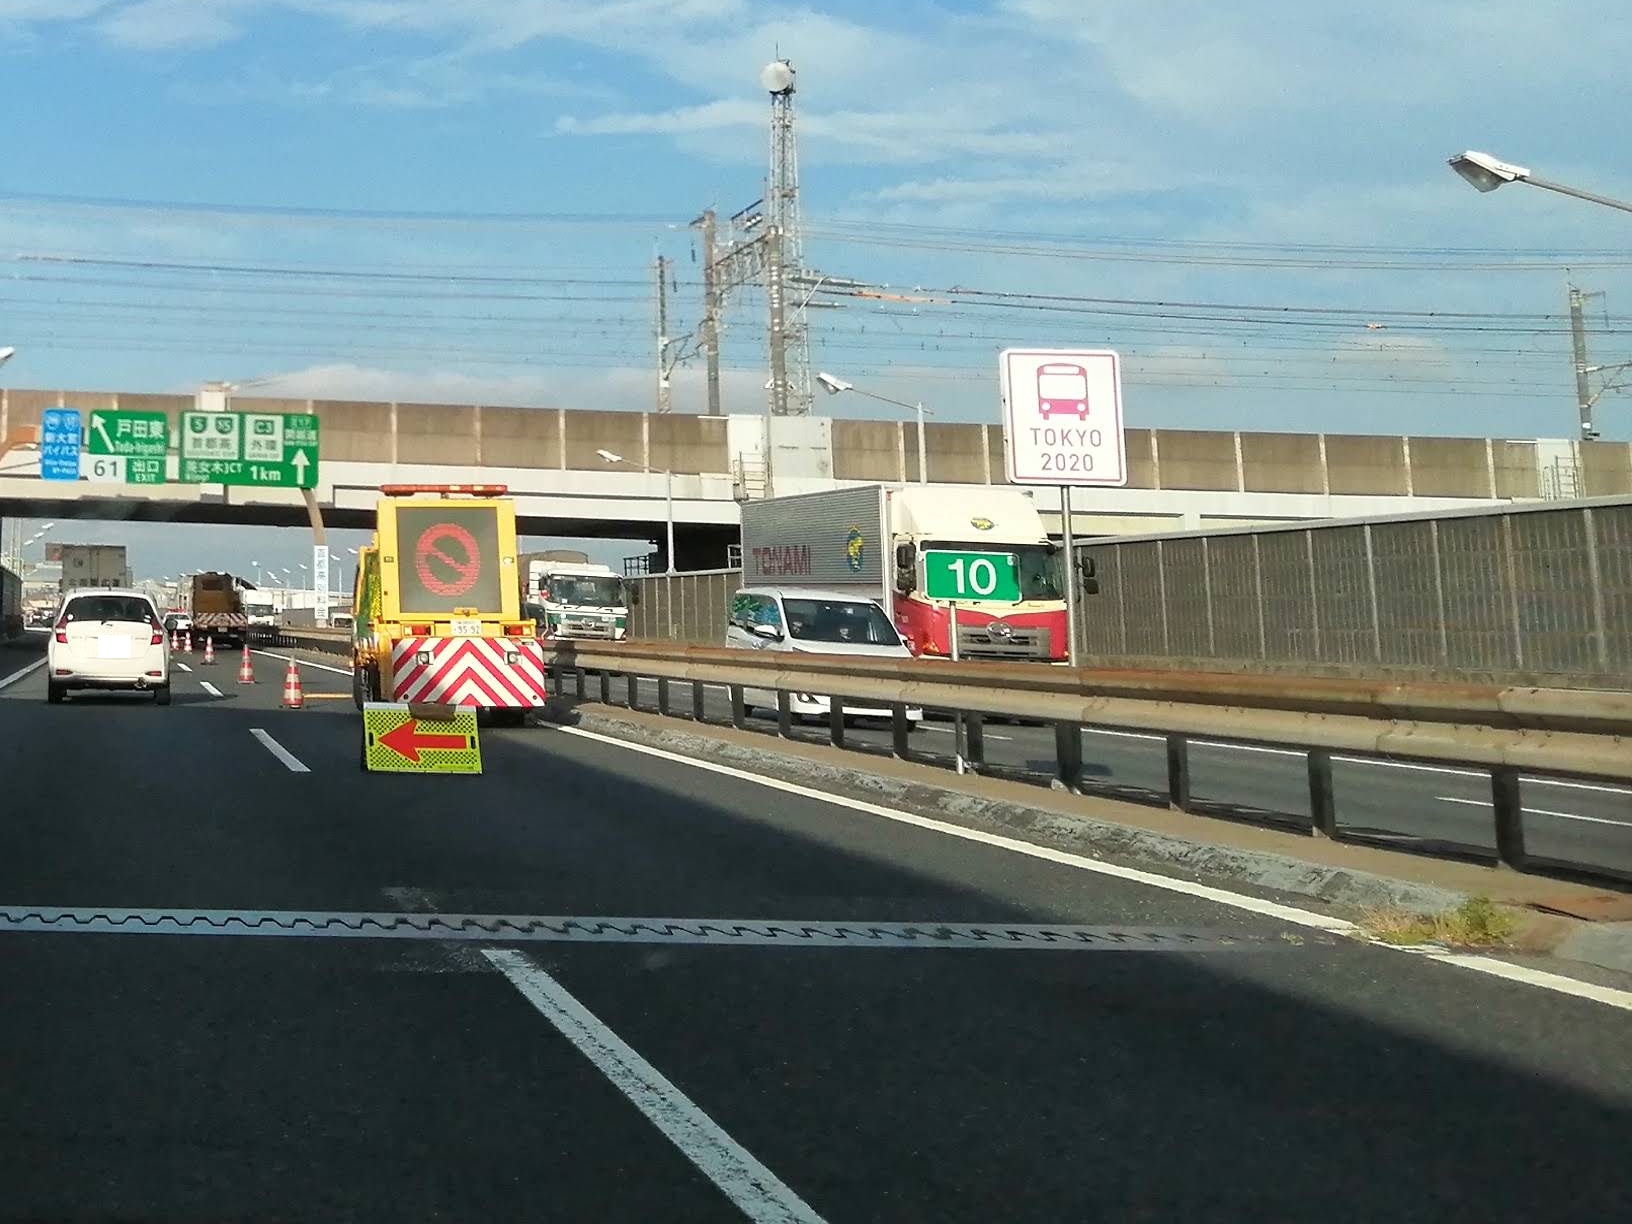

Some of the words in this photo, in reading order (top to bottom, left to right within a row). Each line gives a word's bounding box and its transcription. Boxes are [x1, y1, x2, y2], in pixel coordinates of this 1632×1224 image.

[116, 419, 165, 439] 戸田東
[1029, 427, 1102, 448] TOKYO
[94, 459, 118, 477] 61
[132, 460, 160, 473] 出口
[1041, 453, 1094, 472] 2020
[135, 473, 156, 483] EXIT
[250, 466, 281, 481] 1km
[752, 545, 811, 576] TONAMI
[948, 558, 997, 596] 10
